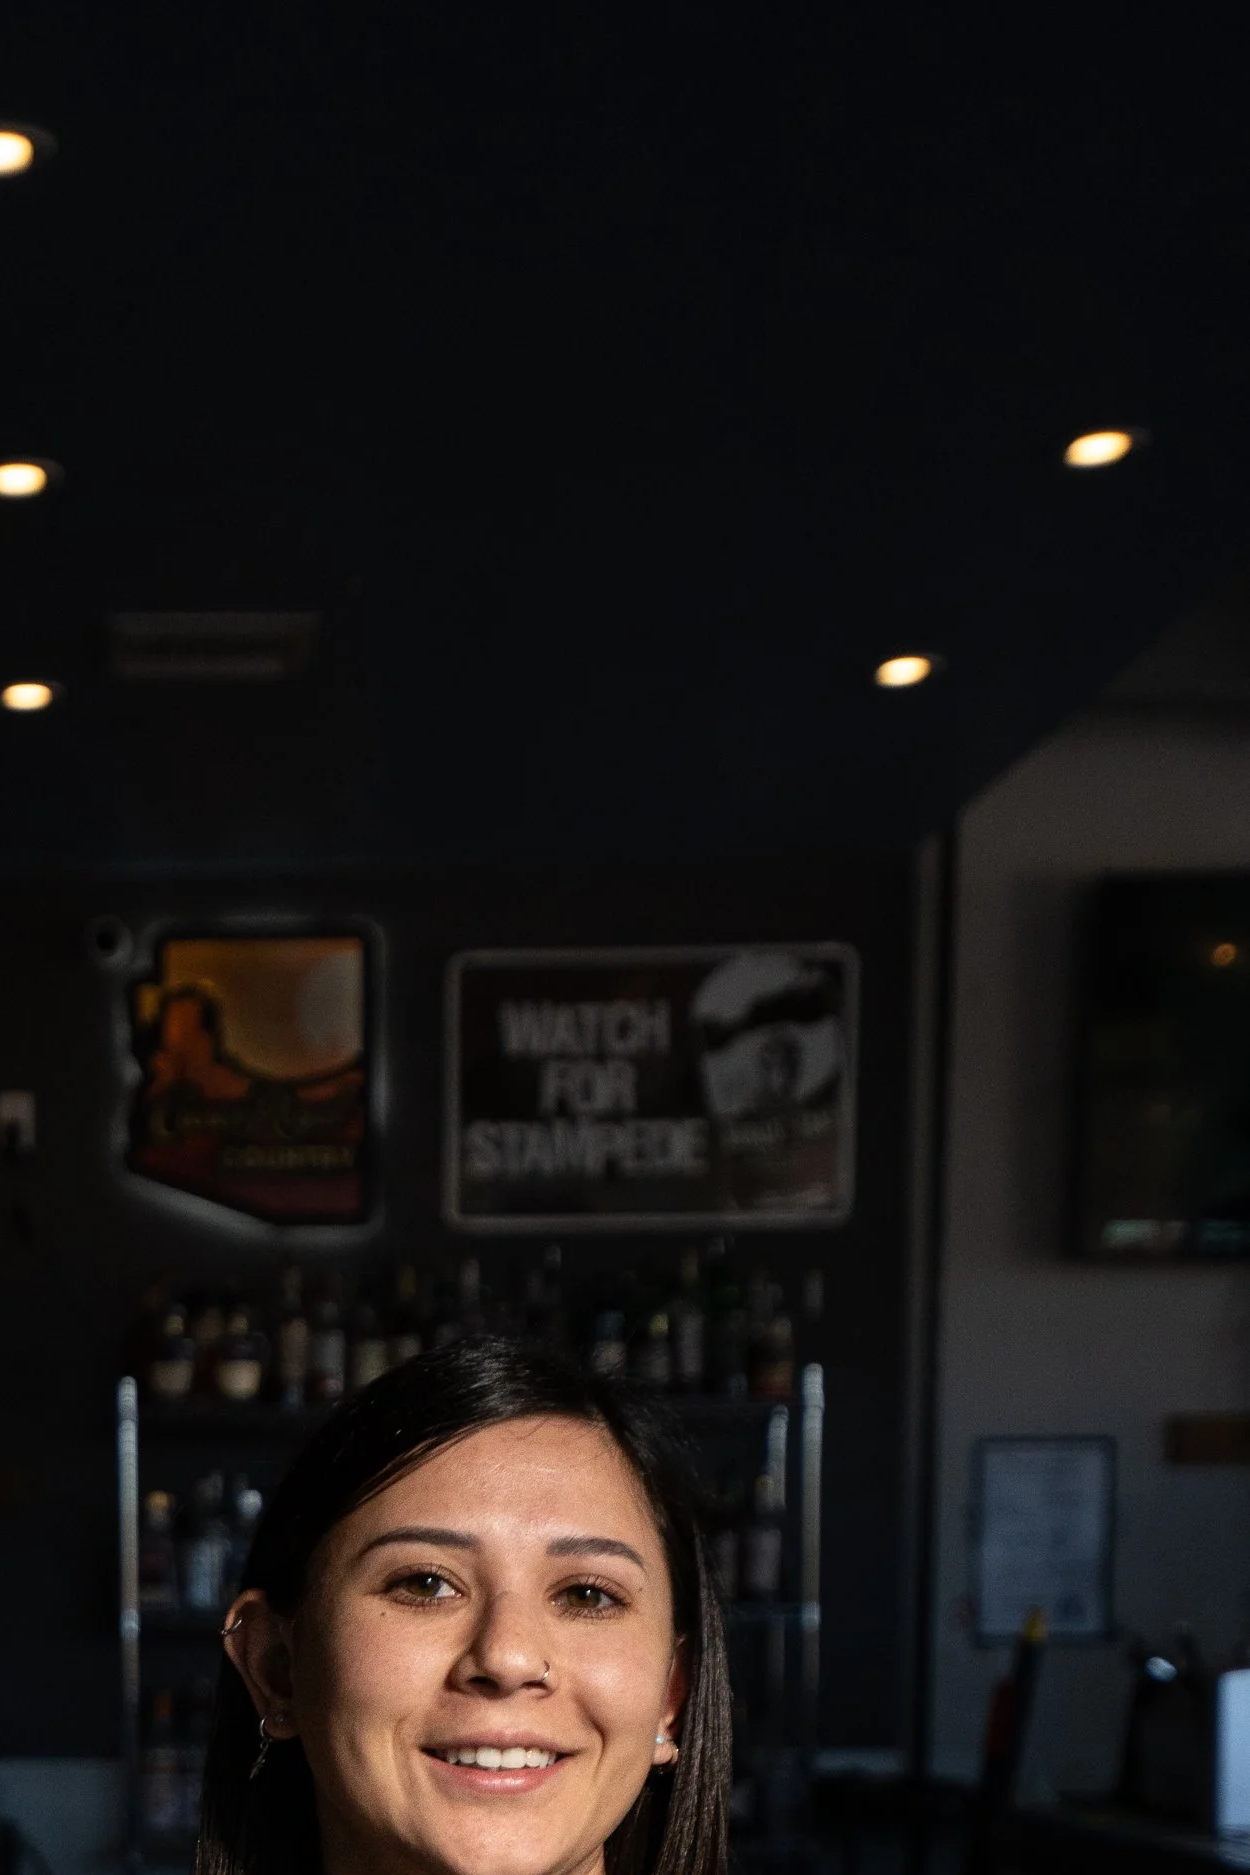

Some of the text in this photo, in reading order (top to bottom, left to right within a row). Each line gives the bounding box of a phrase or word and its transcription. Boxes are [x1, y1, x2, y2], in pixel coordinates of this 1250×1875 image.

[497, 998, 671, 1061] WATCH
[537, 1059, 638, 1118] FOR
[463, 1116, 711, 1179] STAMPEDE
